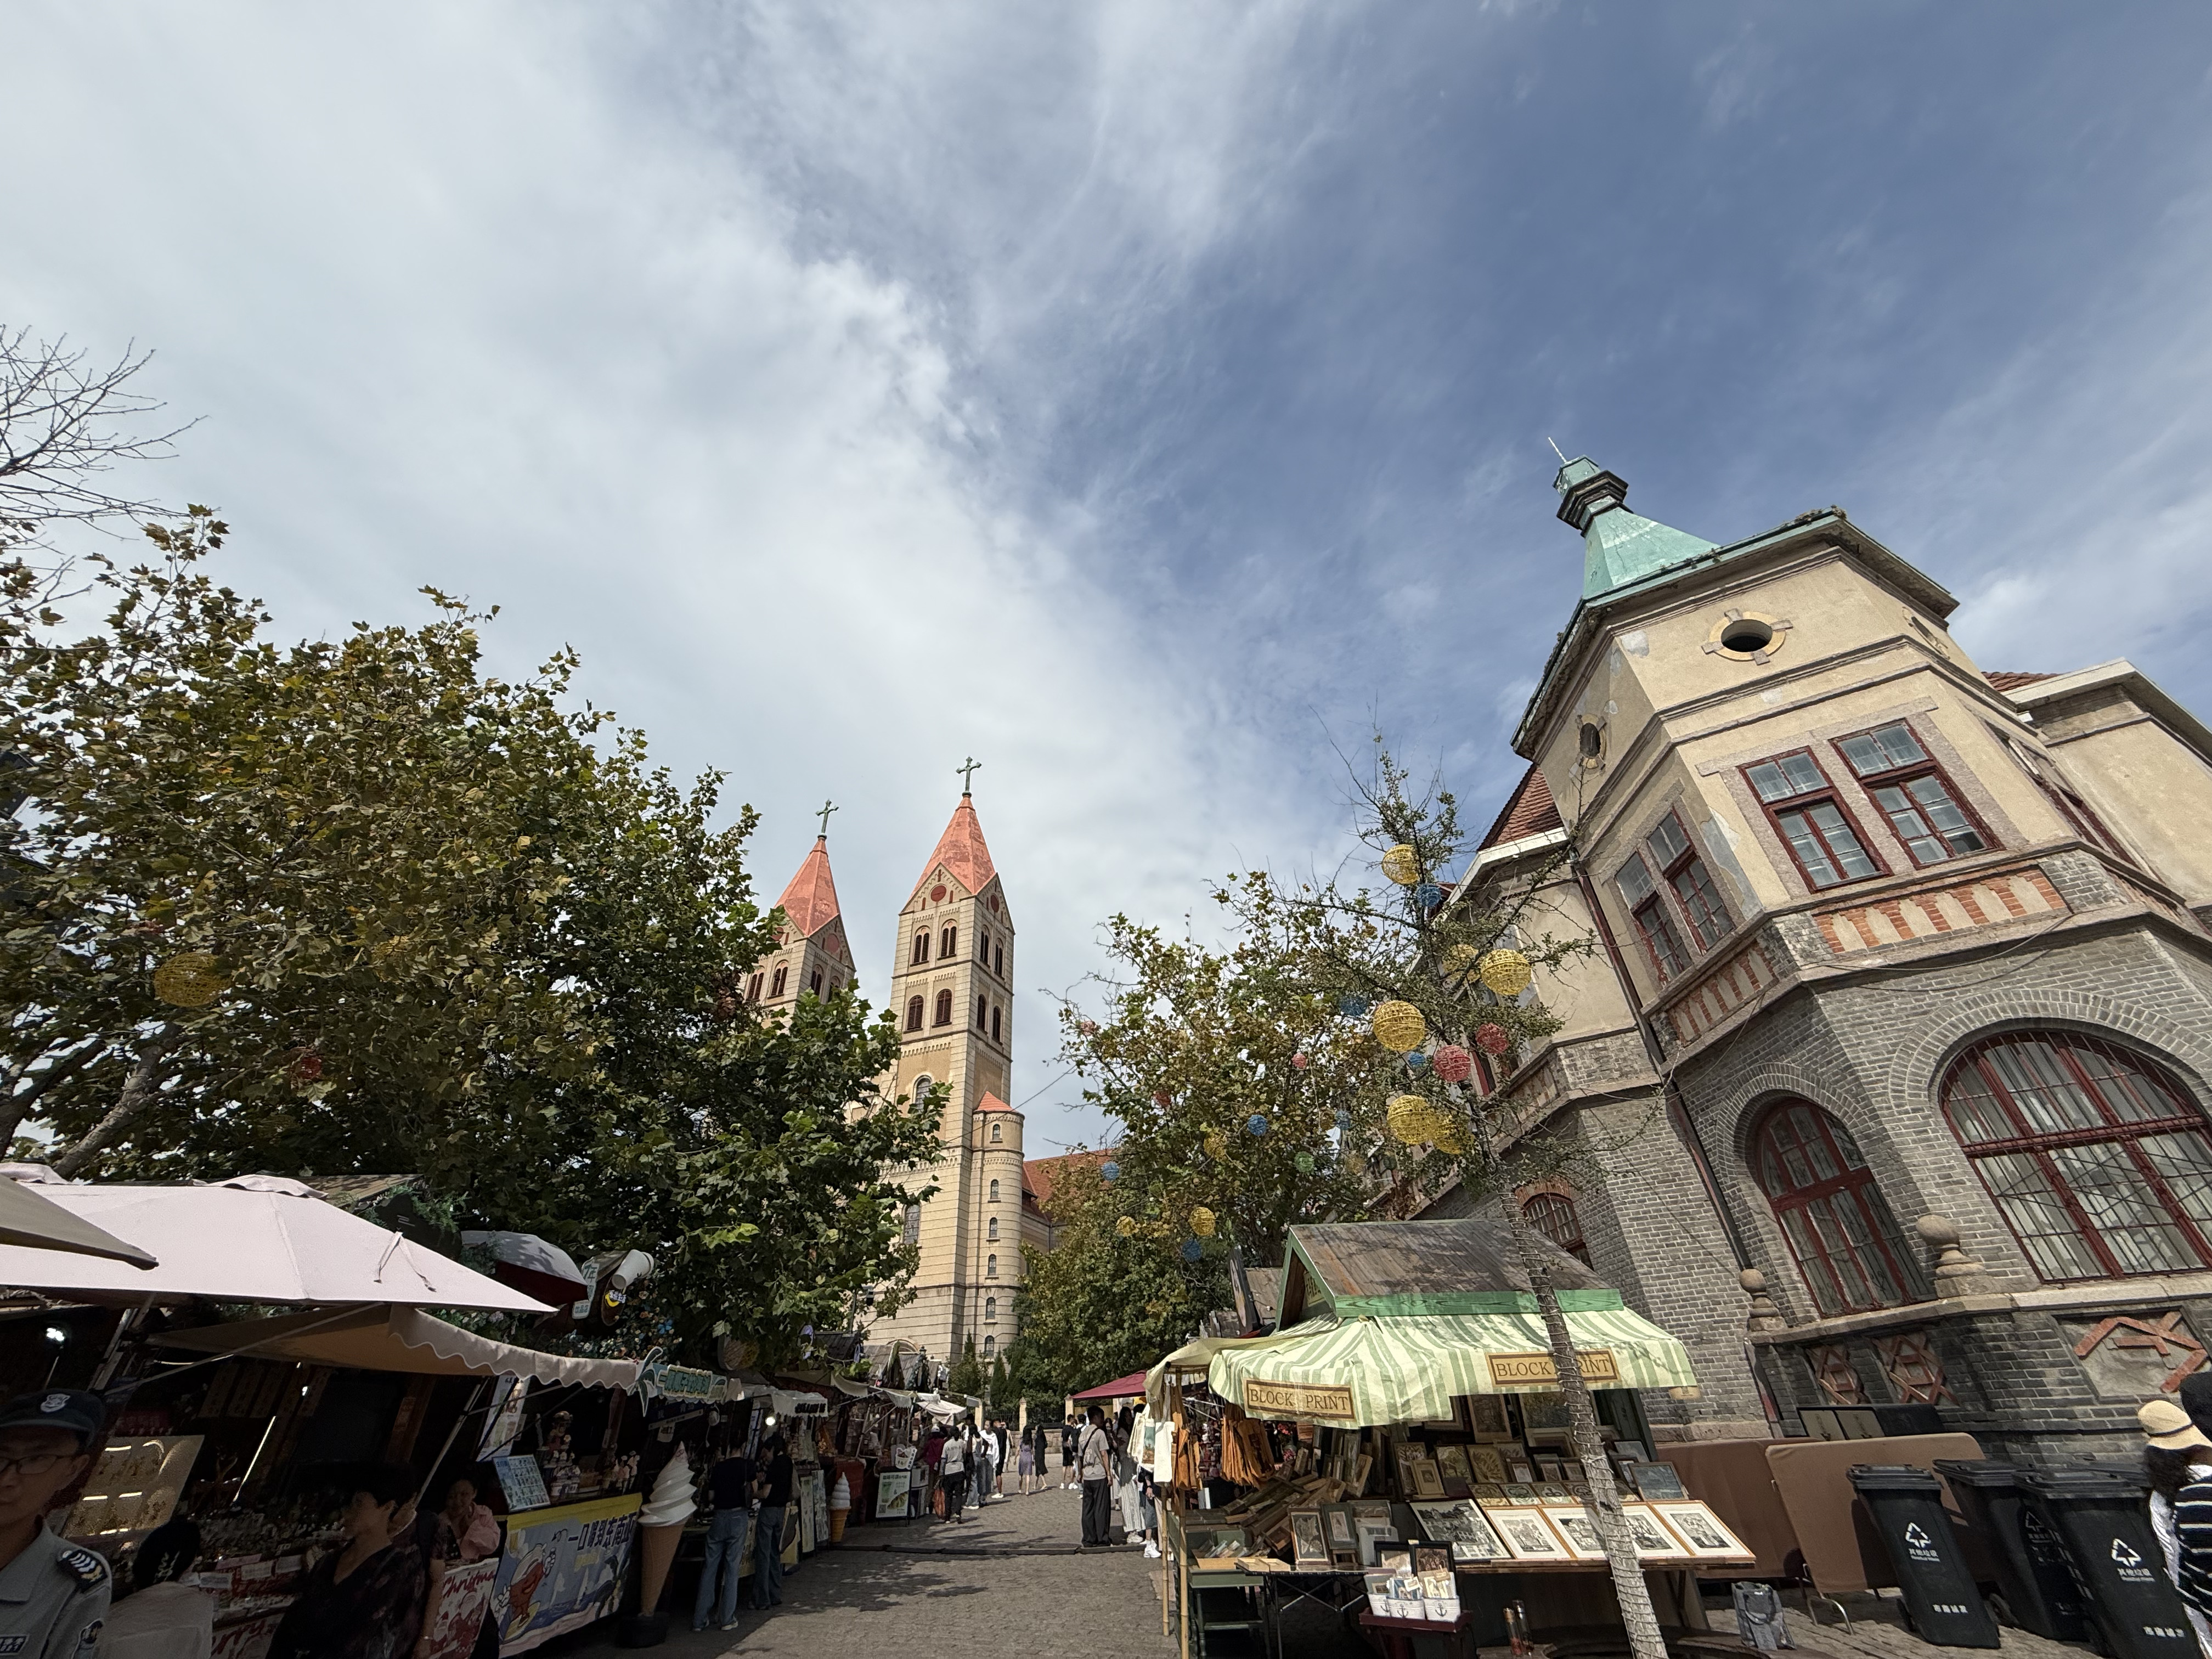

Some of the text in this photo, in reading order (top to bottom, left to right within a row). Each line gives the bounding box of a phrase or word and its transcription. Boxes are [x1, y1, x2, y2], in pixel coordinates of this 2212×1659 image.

[1496, 1361, 1551, 1376] BLOCK
[1250, 1389, 1348, 1410] BLOCK PRINT
